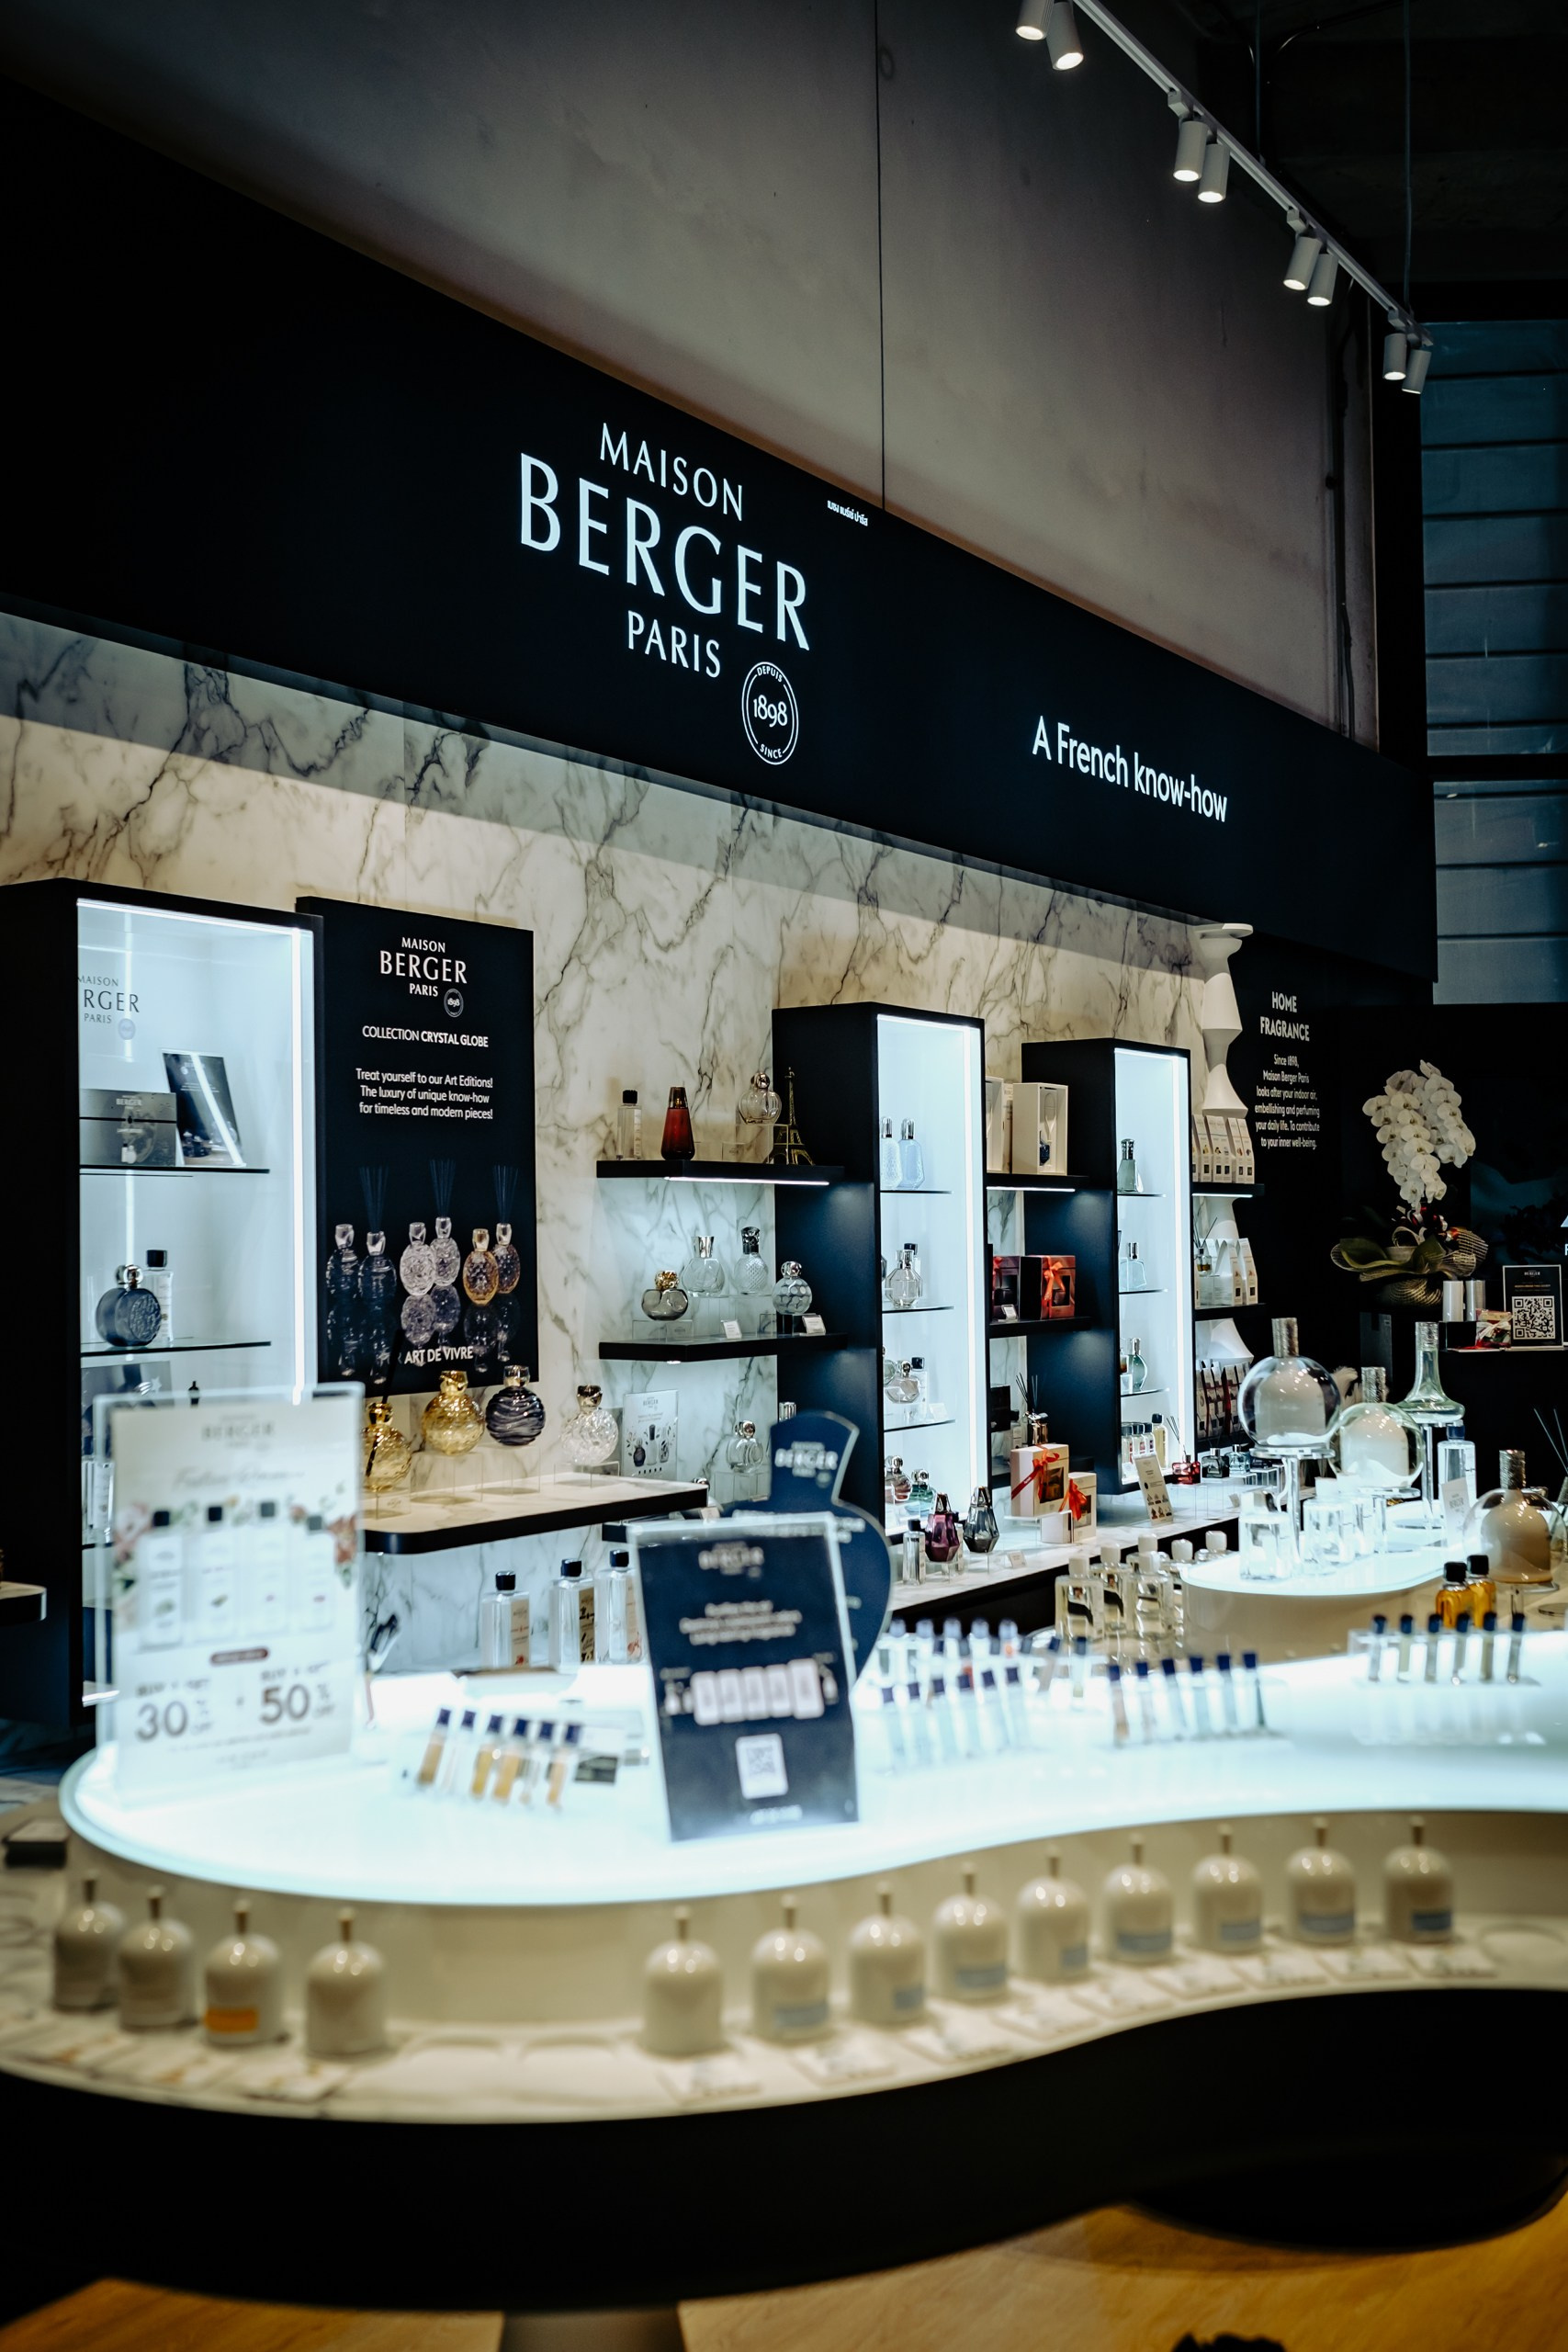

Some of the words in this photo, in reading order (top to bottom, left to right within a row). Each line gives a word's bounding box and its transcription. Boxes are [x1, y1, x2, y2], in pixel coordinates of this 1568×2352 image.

[600, 423, 743, 521] MAISON
[521, 452, 810, 651] BERGER
[628, 610, 721, 678] PARIS
[756, 666, 784, 683] DEPUIS
[753, 695, 788, 728] 1898
[759, 743, 784, 759] SINCE
[1032, 715, 1052, 761] A
[1057, 721, 1129, 787] French
[1134, 752, 1228, 822] know-how
[401, 937, 446, 953] MAISON
[379, 950, 468, 984] BERGER
[410, 983, 439, 997] PARIS
[84, 989, 140, 1013] RGER
[1271, 991, 1297, 1012] HOME
[84, 1012, 112, 1023] PARIS
[362, 1025, 420, 1041] COLLECTION
[421, 1030, 459, 1045] CRYSTAL
[460, 1035, 489, 1047] GLOBE
[1259, 1016, 1310, 1042] FRAGRANCE
[1273, 1054, 1287, 1066] Since
[355, 1068, 380, 1080] Treat
[381, 1071, 416, 1083] yourself
[417, 1073, 427, 1083] to
[428, 1076, 443, 1085] our
[444, 1076, 457, 1086] Art
[459, 1076, 493, 1088] Editions!
[1263, 1069, 1281, 1081] Maison
[1280, 1070, 1297, 1085] Berger
[1298, 1072, 1310, 1083] Paris
[360, 1085, 378, 1097] The
[378, 1087, 405, 1100] luxury
[407, 1088, 416, 1099] of
[418, 1090, 447, 1102] unique
[448, 1091, 490, 1102] know-how
[1256, 1085, 1269, 1097] looks
[1270, 1086, 1282, 1098] after
[1282, 1090, 1293, 1101] your
[1293, 1088, 1310, 1100] indoor
[359, 1102, 373, 1114] for
[374, 1103, 411, 1115] timeless
[412, 1104, 429, 1116] and
[431, 1106, 463, 1118] modern
[465, 1108, 493, 1120] pieces!
[1254, 1102, 1286, 1117] embellishing
[1286, 1104, 1296, 1115] and
[1296, 1104, 1320, 1119] perfuming
[1256, 1121, 1267, 1133] your
[1268, 1119, 1280, 1133] daily
[1280, 1120, 1290, 1131] life.
[1290, 1120, 1296, 1131] To
[1296, 1121, 1320, 1132] contribute
[1261, 1136, 1268, 1147] to
[1268, 1138, 1279, 1149] your
[1279, 1136, 1292, 1148] inner
[1292, 1136, 1317, 1150] well-being.
[404, 1349, 425, 1364] ART
[427, 1348, 442, 1362] DE
[443, 1345, 474, 1360] VIVRE
[259, 1684, 310, 1726] 50
[135, 1702, 188, 1743] 30
